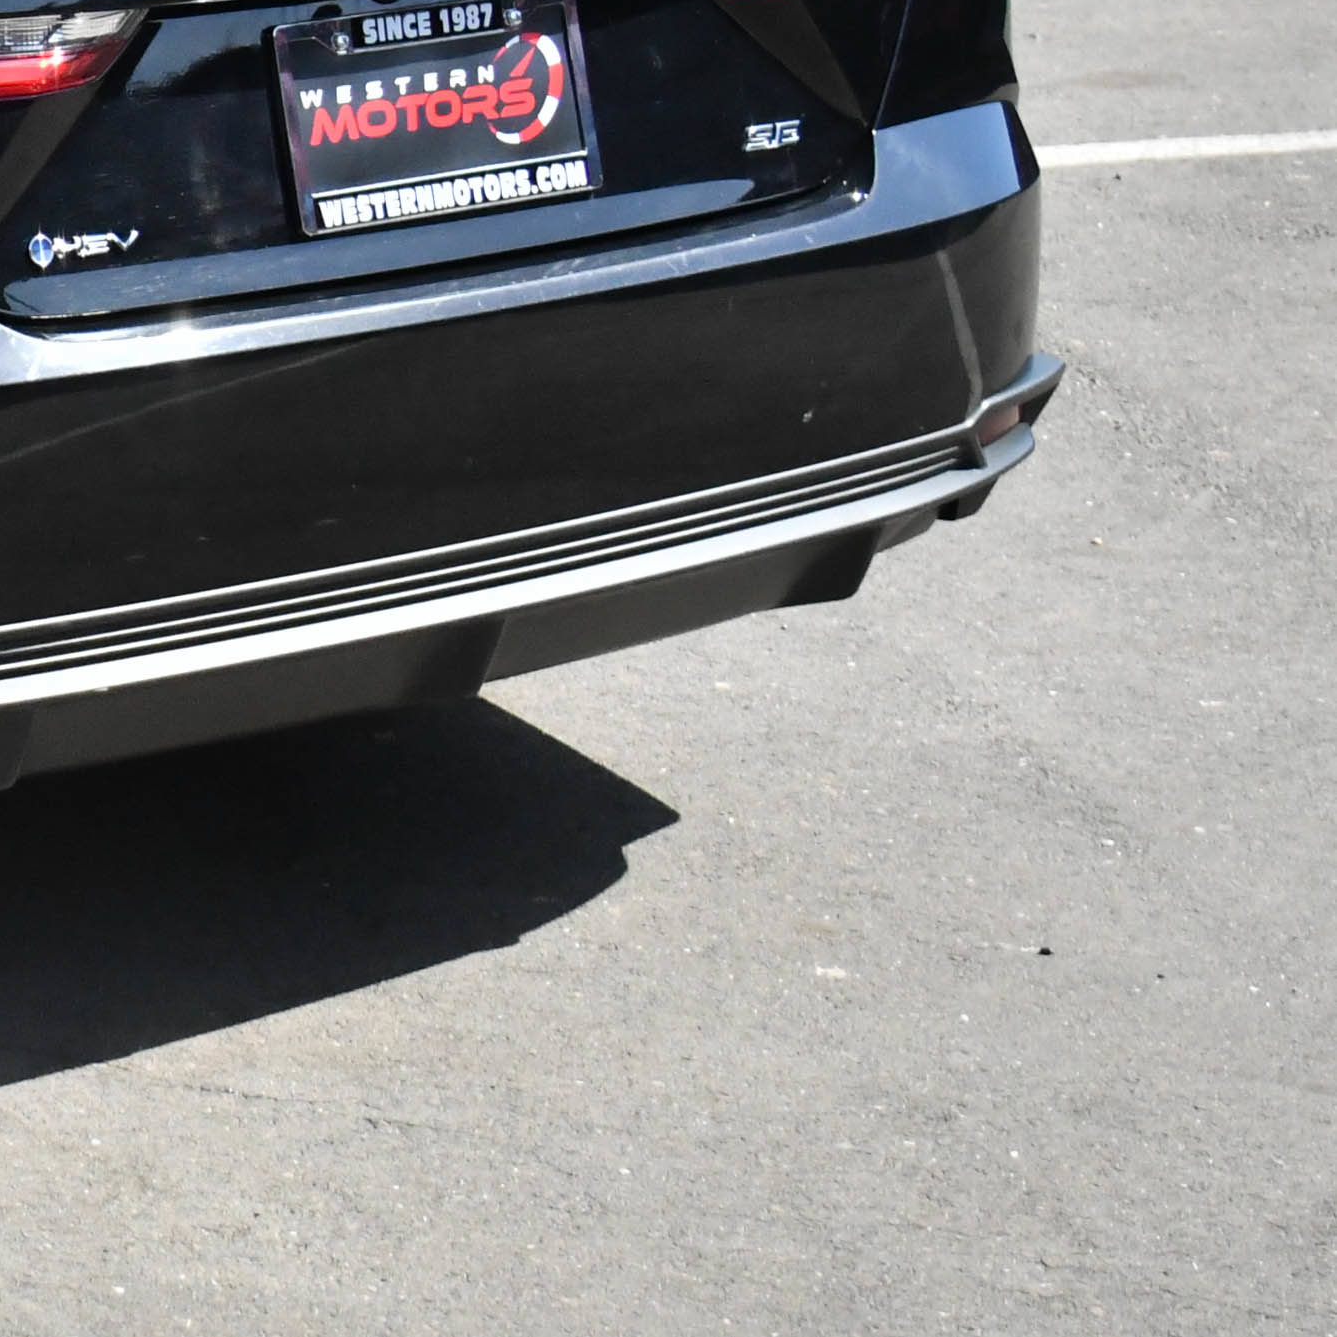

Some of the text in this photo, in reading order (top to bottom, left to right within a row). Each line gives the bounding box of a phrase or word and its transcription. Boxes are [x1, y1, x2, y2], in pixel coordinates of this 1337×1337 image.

[361, 2, 494, 45] SINCE 1987
[299, 64, 495, 110] WESTERN
[309, 77, 536, 147] MOTORS
[745, 119, 801, 153] SE
[318, 160, 588, 228] WESTERNMOTORS.COM
[51, 228, 140, 260] HEV
